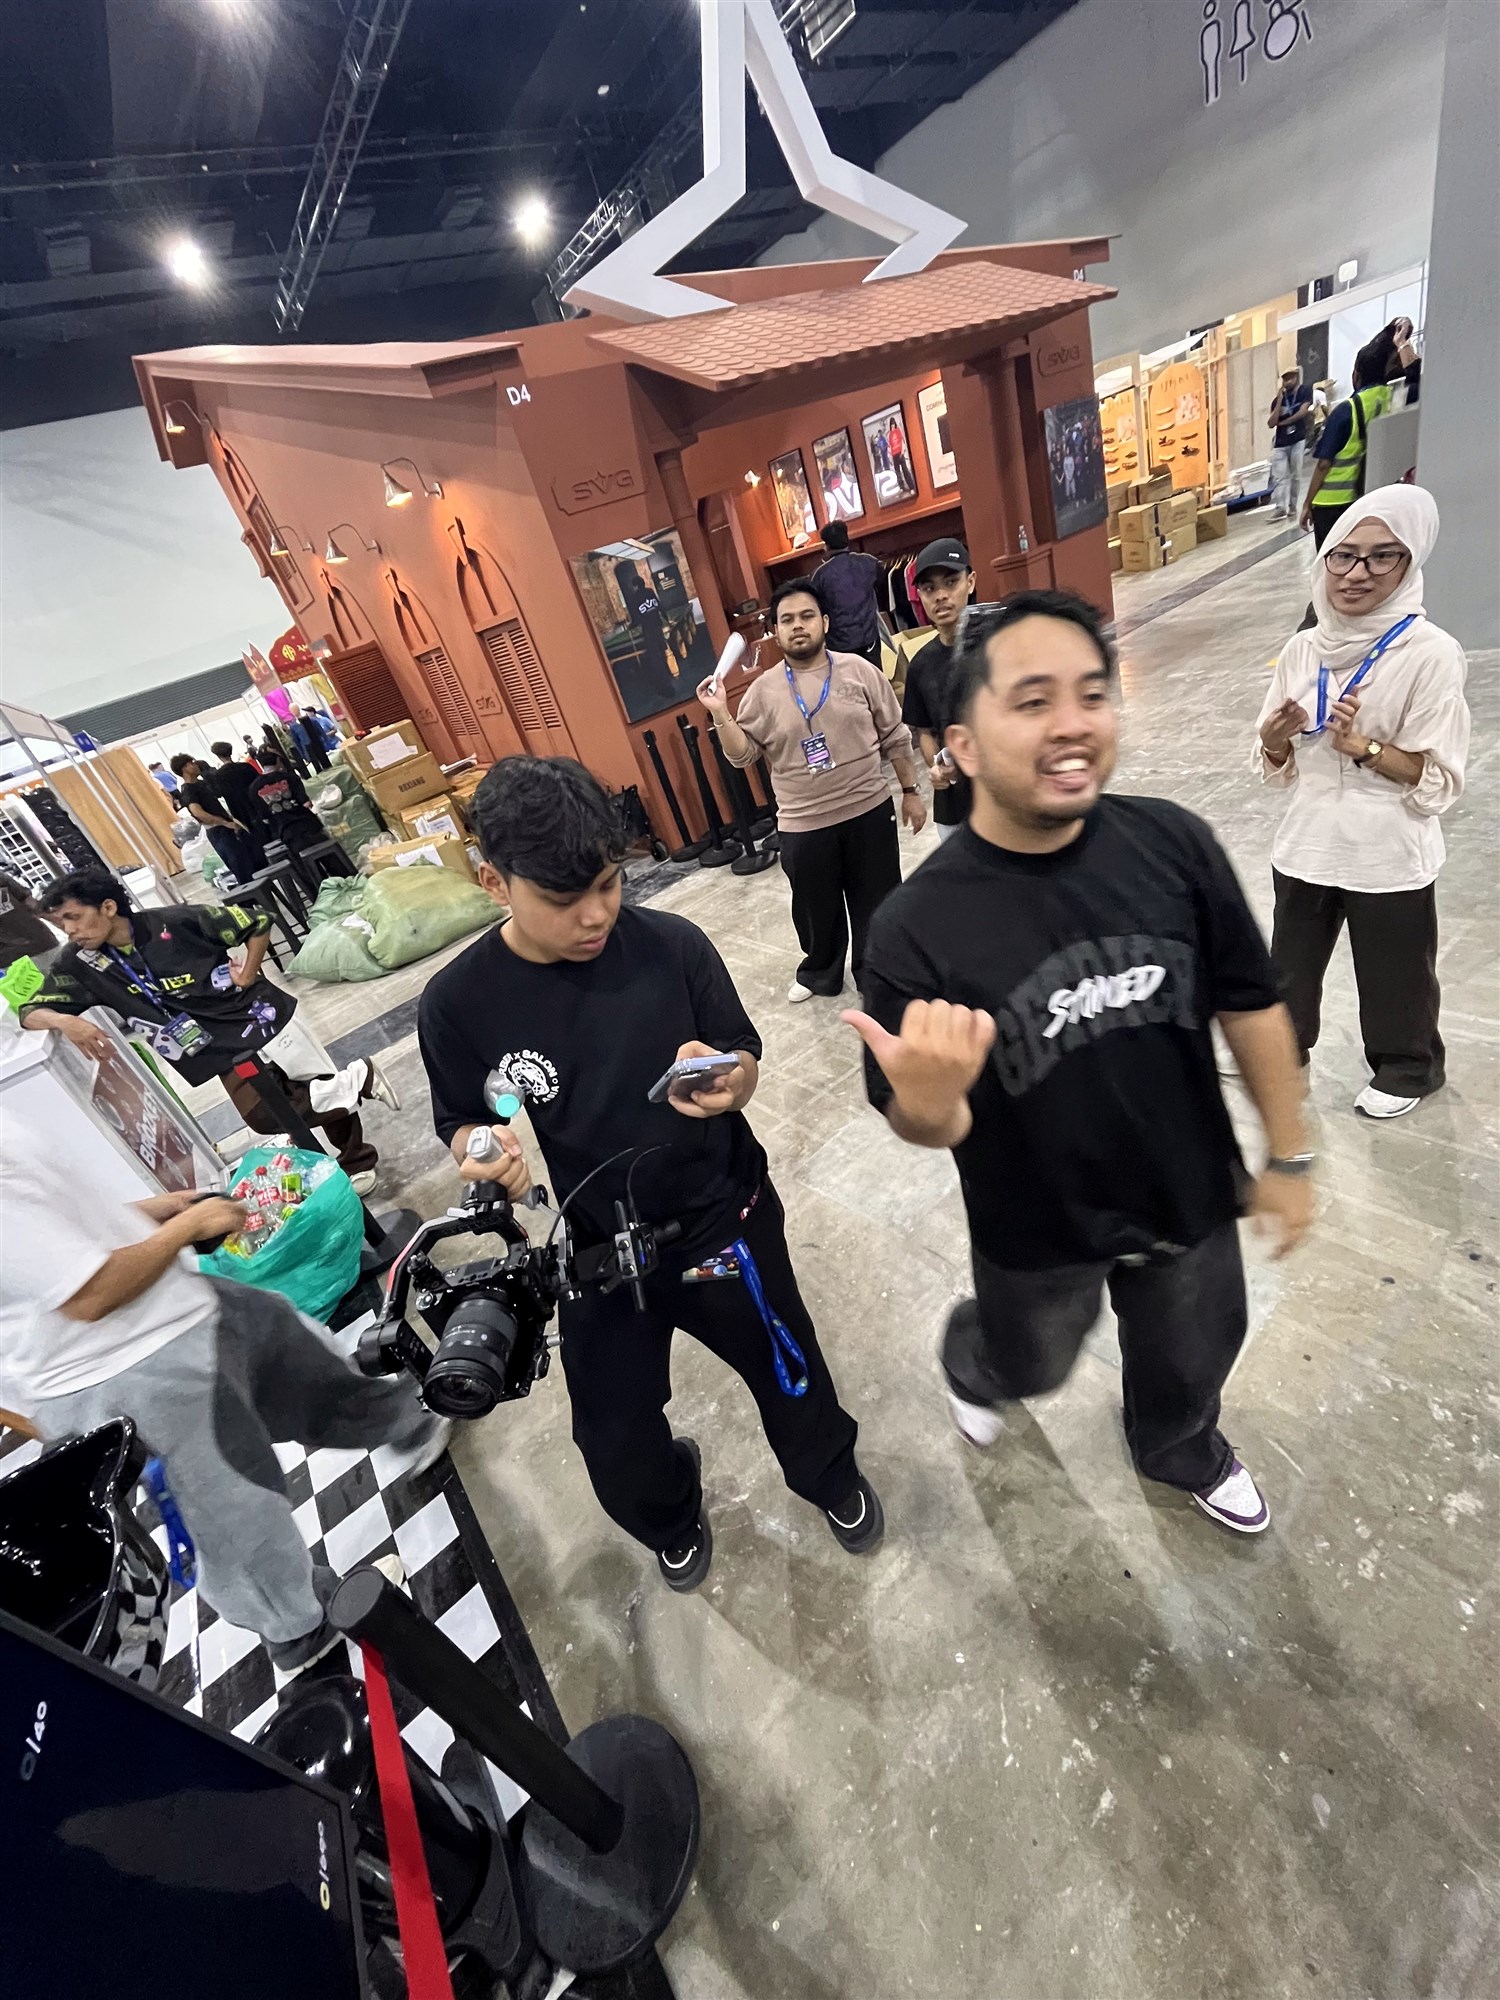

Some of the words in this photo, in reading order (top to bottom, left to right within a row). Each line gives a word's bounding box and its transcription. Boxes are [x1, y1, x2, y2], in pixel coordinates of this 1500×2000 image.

[506, 384, 531, 406] D4
[573, 469, 635, 501] SVG
[522, 1049, 558, 1078] SALON
